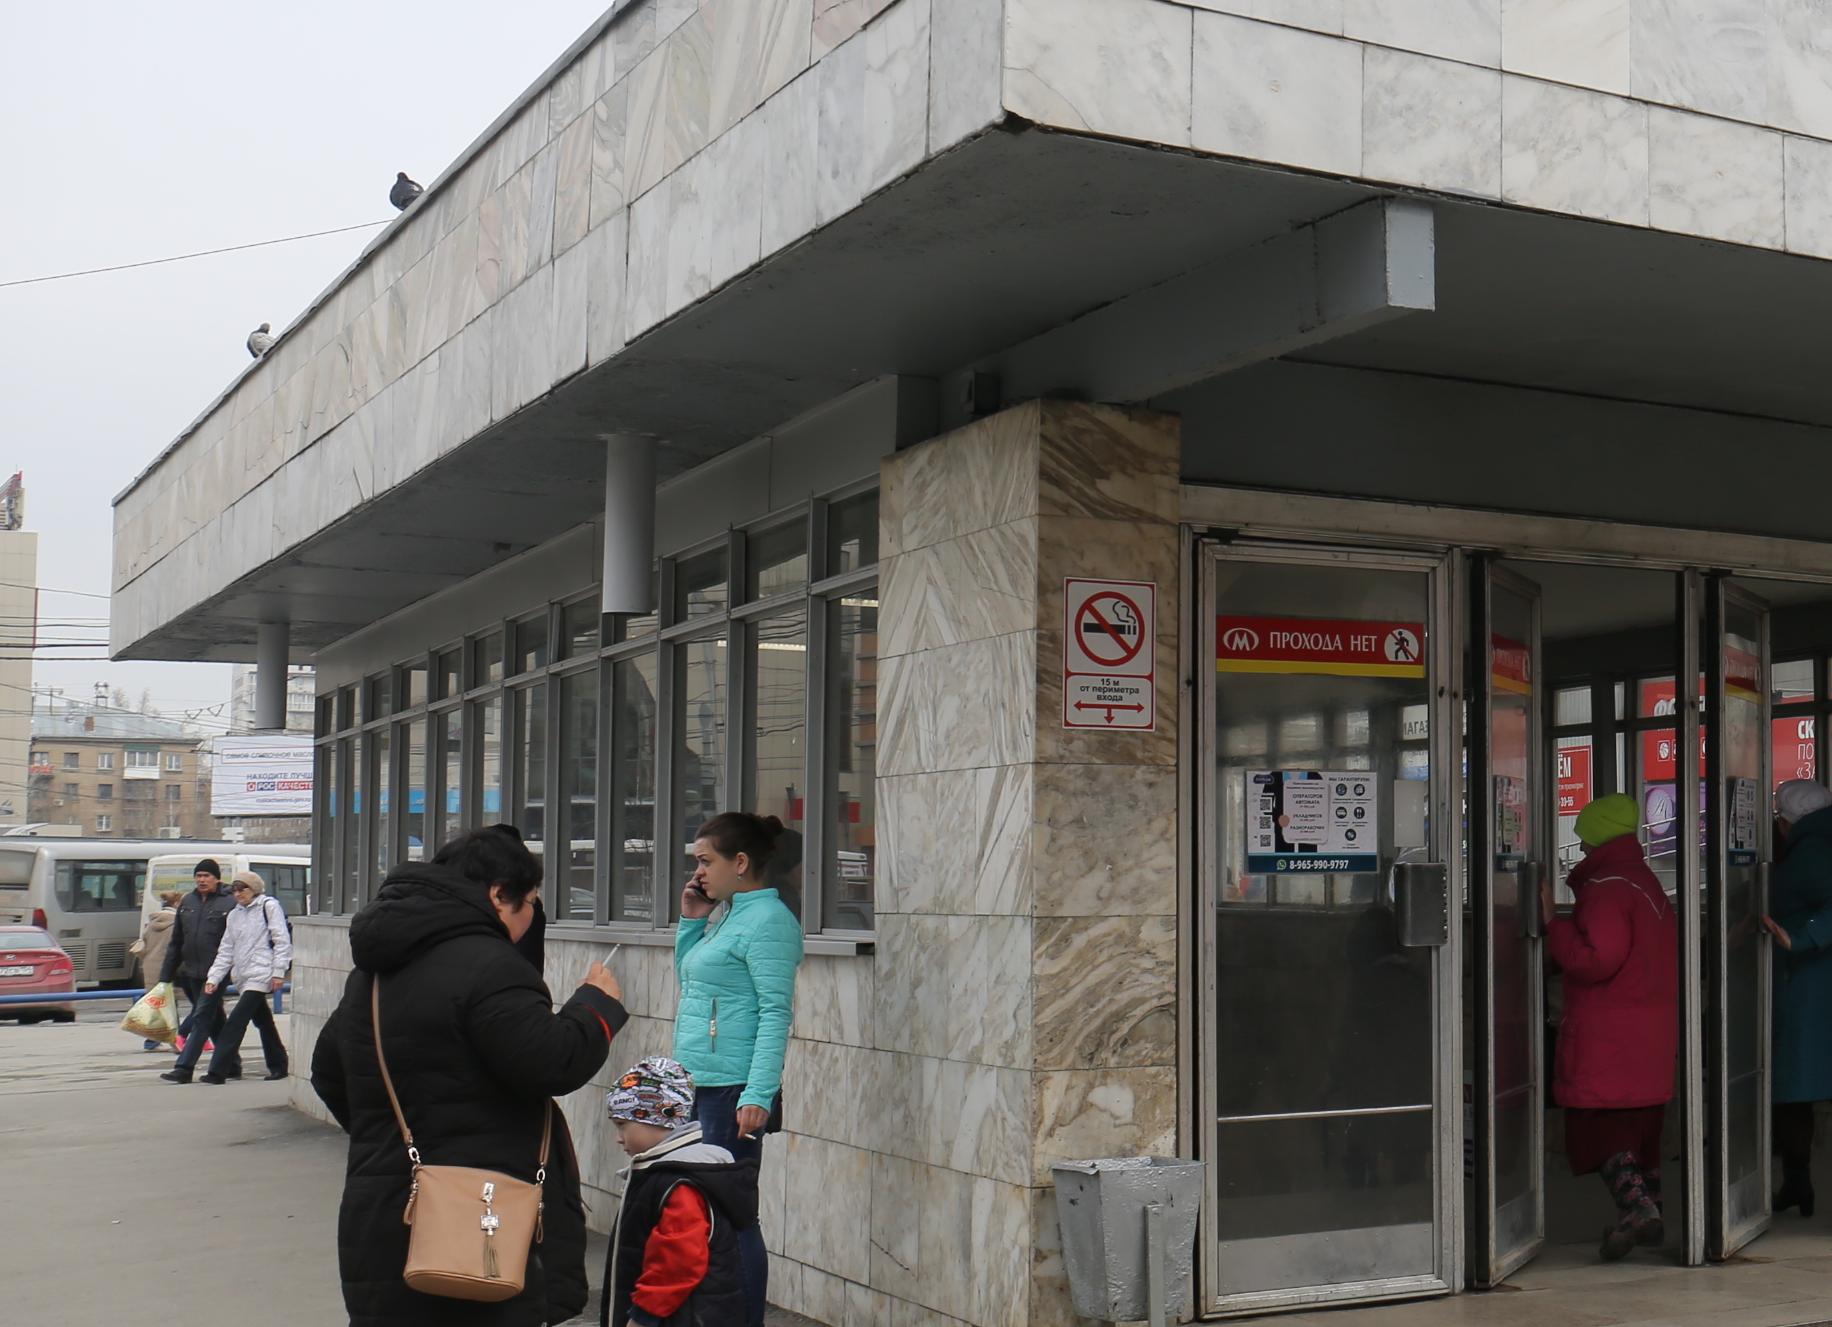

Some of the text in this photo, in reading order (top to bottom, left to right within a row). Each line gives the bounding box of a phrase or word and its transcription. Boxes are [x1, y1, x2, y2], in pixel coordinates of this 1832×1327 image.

[1269, 631, 1343, 651] ПРОХОДА
[1350, 635, 1378, 652] НЕТ
[1101, 678, 1111, 686] 15
[1092, 687, 1140, 696] периметра
[1096, 694, 1124, 702] входа
[1289, 859, 1349, 870] 8-965-990-9797
